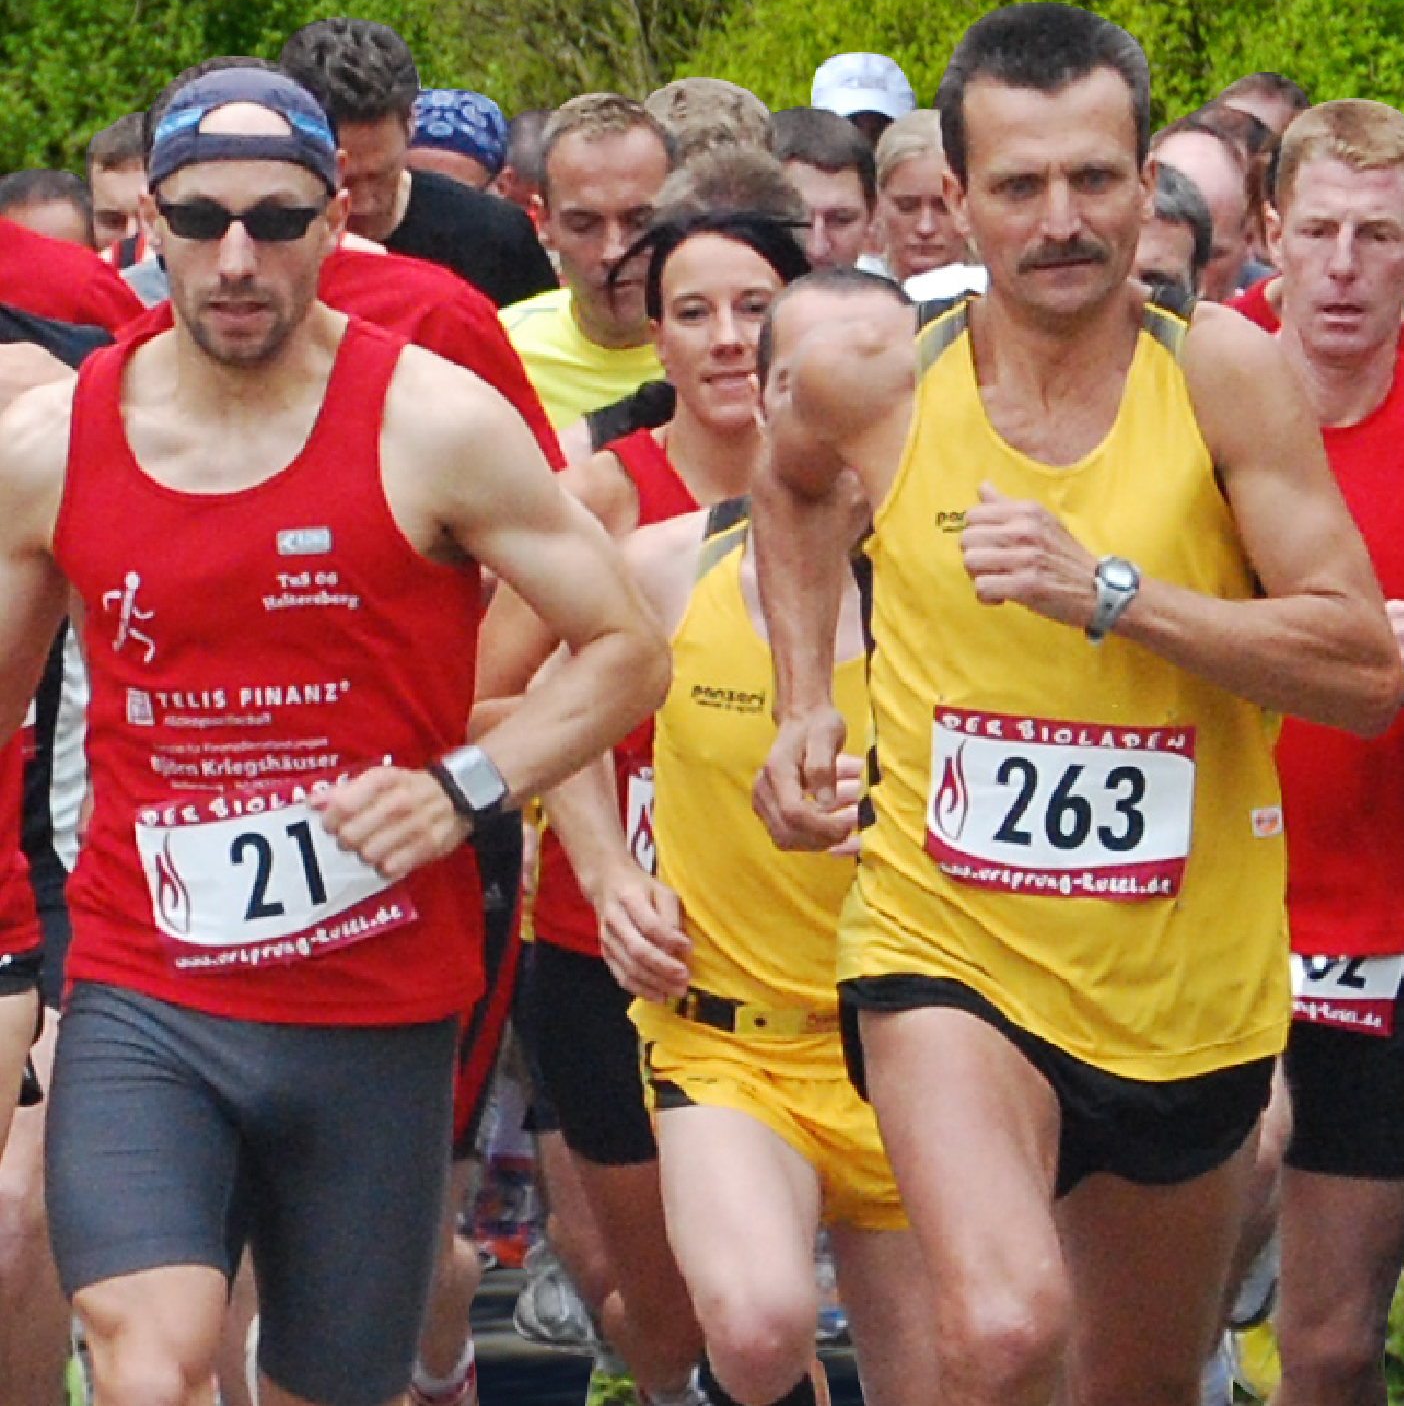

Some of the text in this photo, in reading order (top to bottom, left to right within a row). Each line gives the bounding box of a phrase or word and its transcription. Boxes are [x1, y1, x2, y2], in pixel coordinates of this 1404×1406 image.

[156, 688, 227, 709] TELIS
[940, 712, 1187, 751] DER BIOLADEN
[139, 754, 393, 826] DER BIOLADE
[992, 756, 1147, 852] 263
[229, 819, 328, 922] 21
